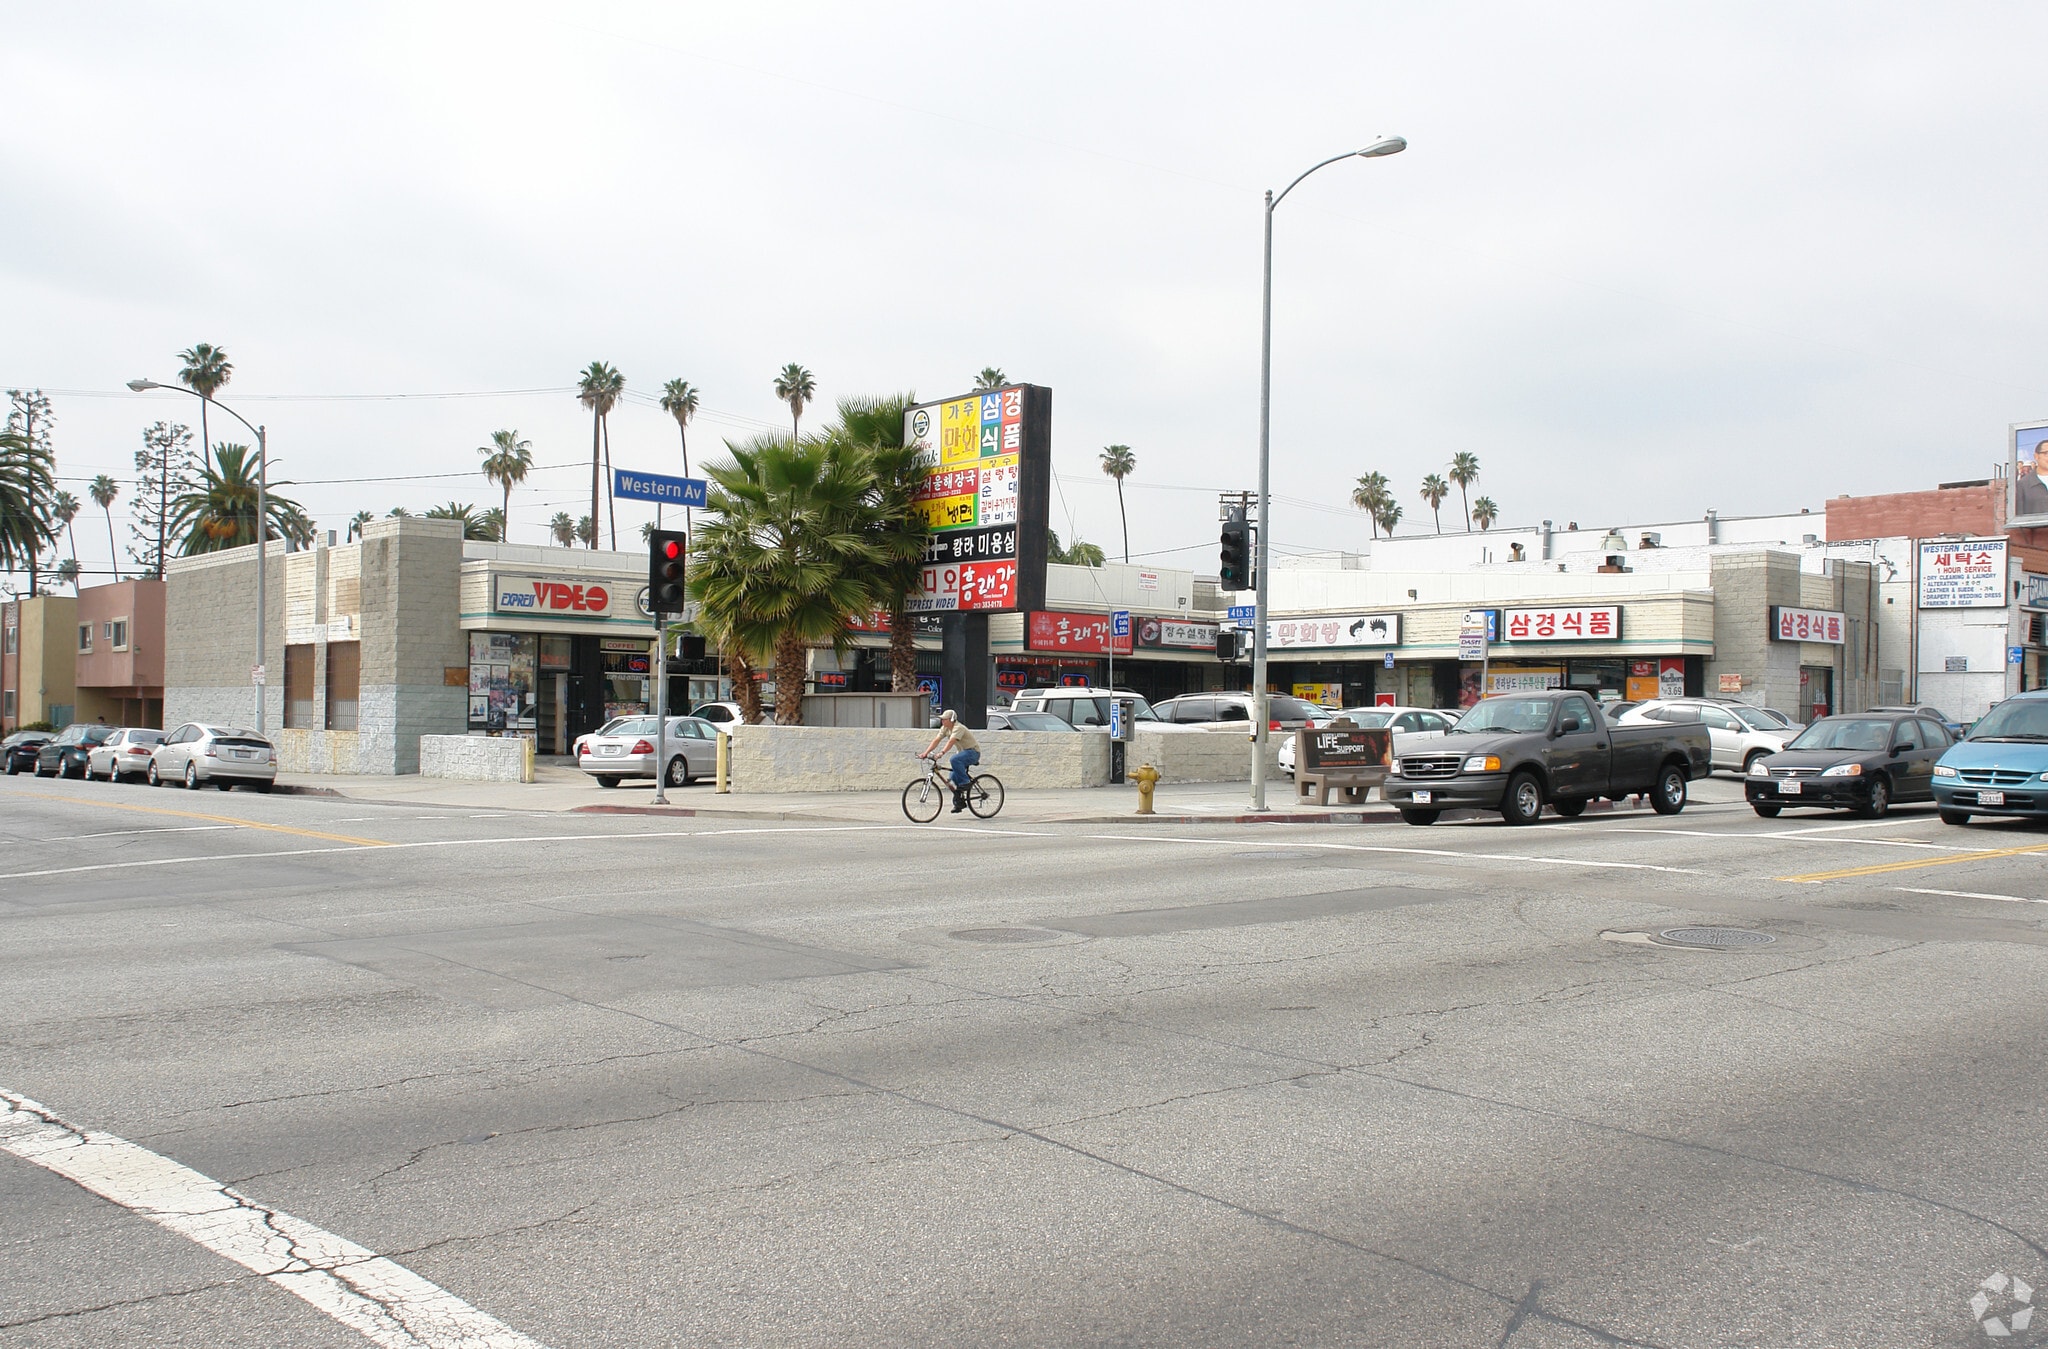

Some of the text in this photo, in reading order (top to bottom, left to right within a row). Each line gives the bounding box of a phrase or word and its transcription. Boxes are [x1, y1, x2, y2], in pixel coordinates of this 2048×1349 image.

[982, 389, 1022, 421] 삼경
[944, 424, 978, 459] 만화
[981, 422, 1021, 452] 식품
[621, 476, 702, 500] Western Av
[978, 530, 1016, 555] 미용실
[1923, 542, 2004, 553] WESTERN CLEANERS
[1934, 551, 1993, 567] 세탁소
[1943, 566, 1961, 574] HOUR
[1964, 565, 1992, 573] SERVICE
[501, 582, 609, 612] EXPRESS VIDEO
[935, 597, 957, 609] VIDEO
[1231, 607, 1253, 617] 4th St
[1278, 622, 1341, 646] 만화방
[1510, 611, 1611, 638] 삼경식품
[1780, 612, 1841, 641] 삼경식품
[628, 660, 648, 670] OPEN
[1667, 686, 1682, 696] 3.69
[1316, 736, 1338, 749] LIFE
[1336, 744, 1365, 753] SUPPORT
